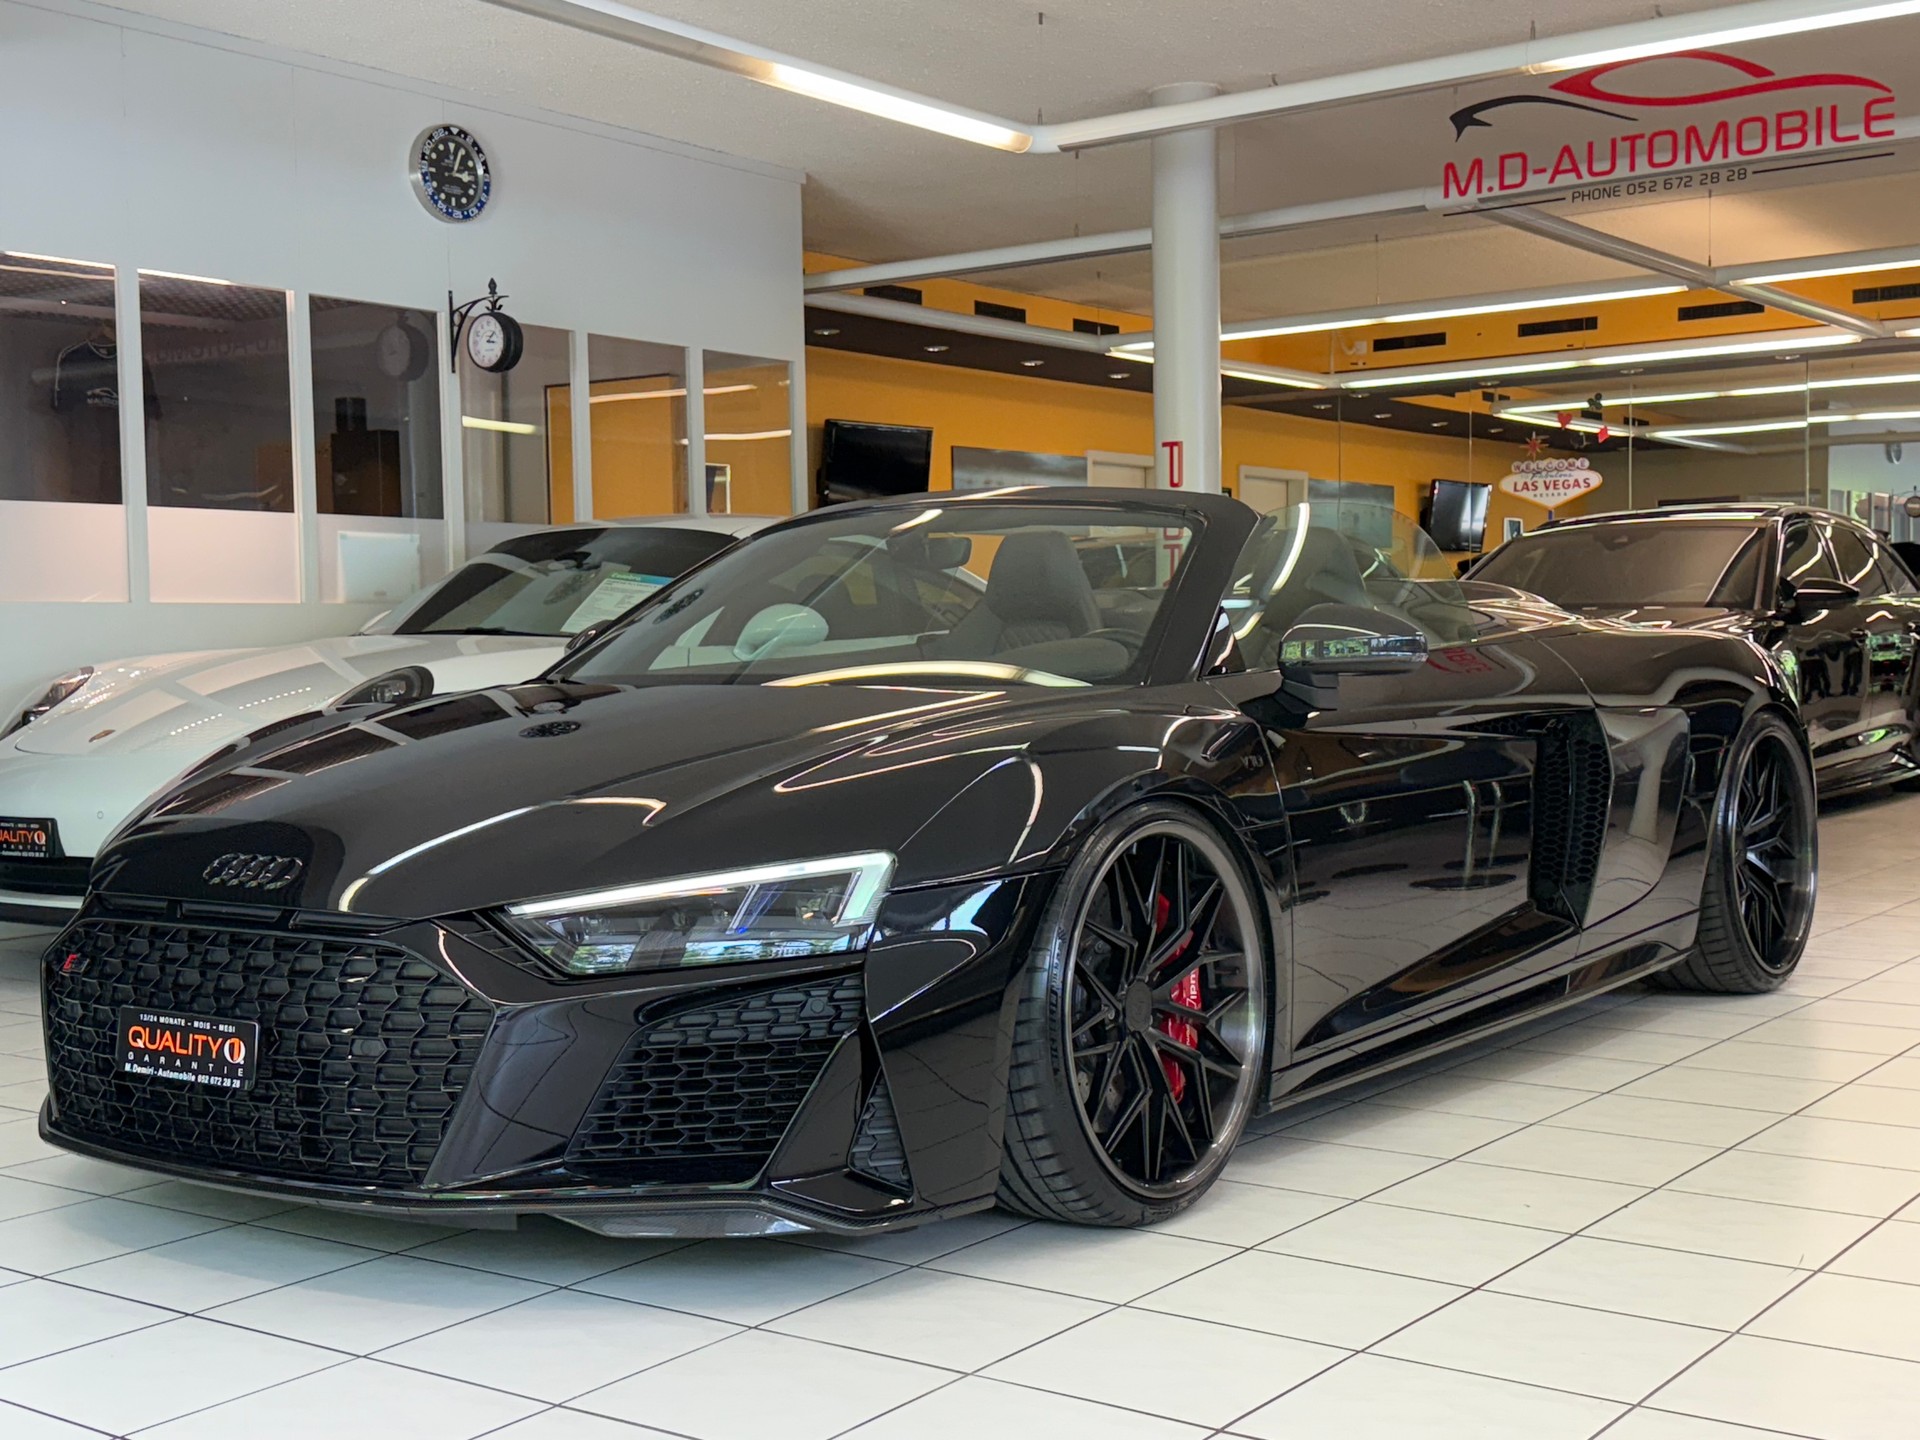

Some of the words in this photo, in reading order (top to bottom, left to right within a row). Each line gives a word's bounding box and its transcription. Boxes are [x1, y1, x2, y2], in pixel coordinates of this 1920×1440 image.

[1443, 96, 1895, 199] M.D-AUTOMOBILE
[1571, 185, 1621, 204] PHONE
[1626, 180, 1658, 196] 052
[1663, 175, 1693, 191] 672
[1699, 172, 1721, 186] 28
[1726, 167, 1748, 182] 28
[1512, 458, 1588, 472] WELCOME
[1513, 480, 1539, 493] LAS
[1543, 477, 1592, 491] VEGAS
[128, 1025, 223, 1060] QUALITY
[128, 1051, 244, 1077] GARANTIE
